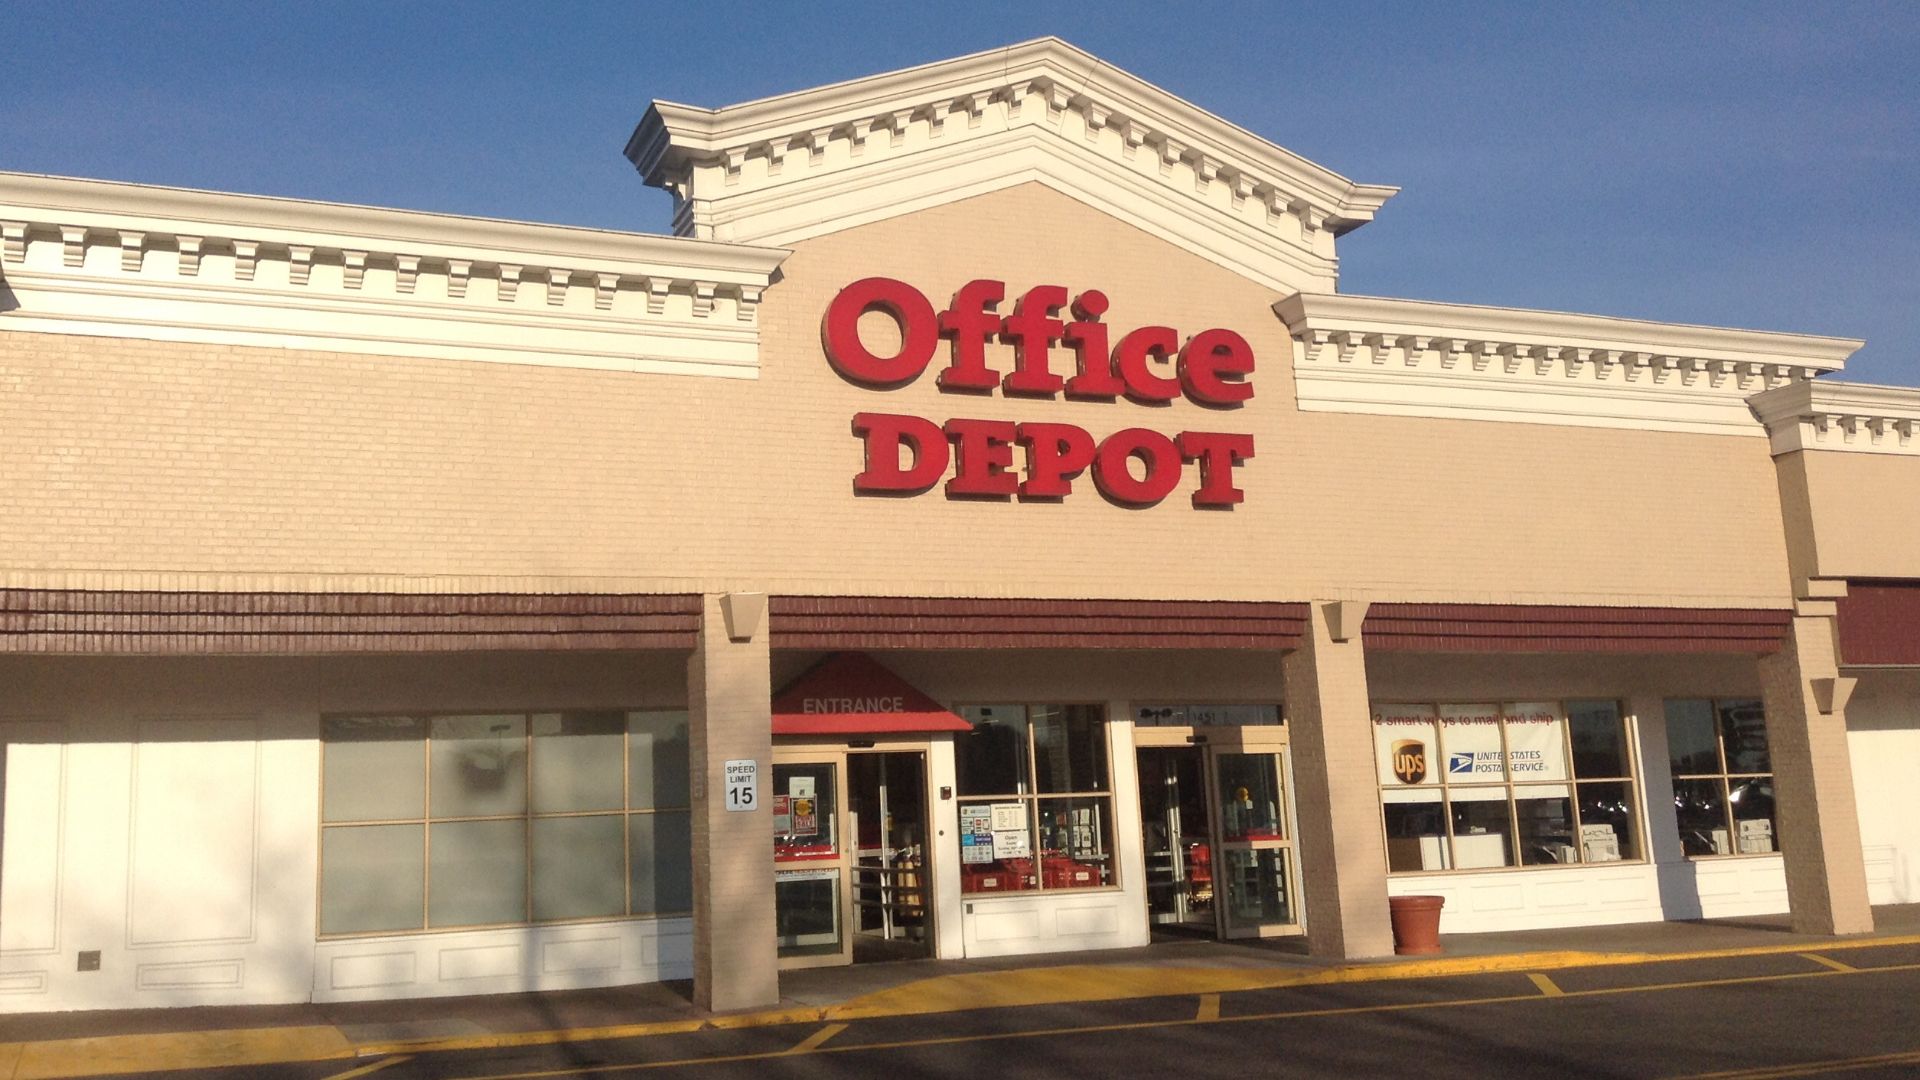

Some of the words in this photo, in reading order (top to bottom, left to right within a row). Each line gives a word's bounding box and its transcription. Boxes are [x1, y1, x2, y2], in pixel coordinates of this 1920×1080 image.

[822, 276, 1255, 410] Office
[852, 412, 1255, 510] DEPOT
[802, 697, 904, 715] ENTRANCE
[1375, 713, 1382, 726] 2
[1386, 713, 1423, 726] smart
[1424, 715, 1456, 729] wys
[1458, 715, 1471, 726] to
[1529, 711, 1554, 727] ship
[1477, 752, 1504, 761] UNITE
[1510, 750, 1541, 760] STATES
[726, 765, 756, 774] SPEED
[1394, 754, 1425, 781] ups
[1475, 764, 1505, 773] POSTA
[729, 775, 752, 784] LIMIT
[729, 787, 753, 805] 15
